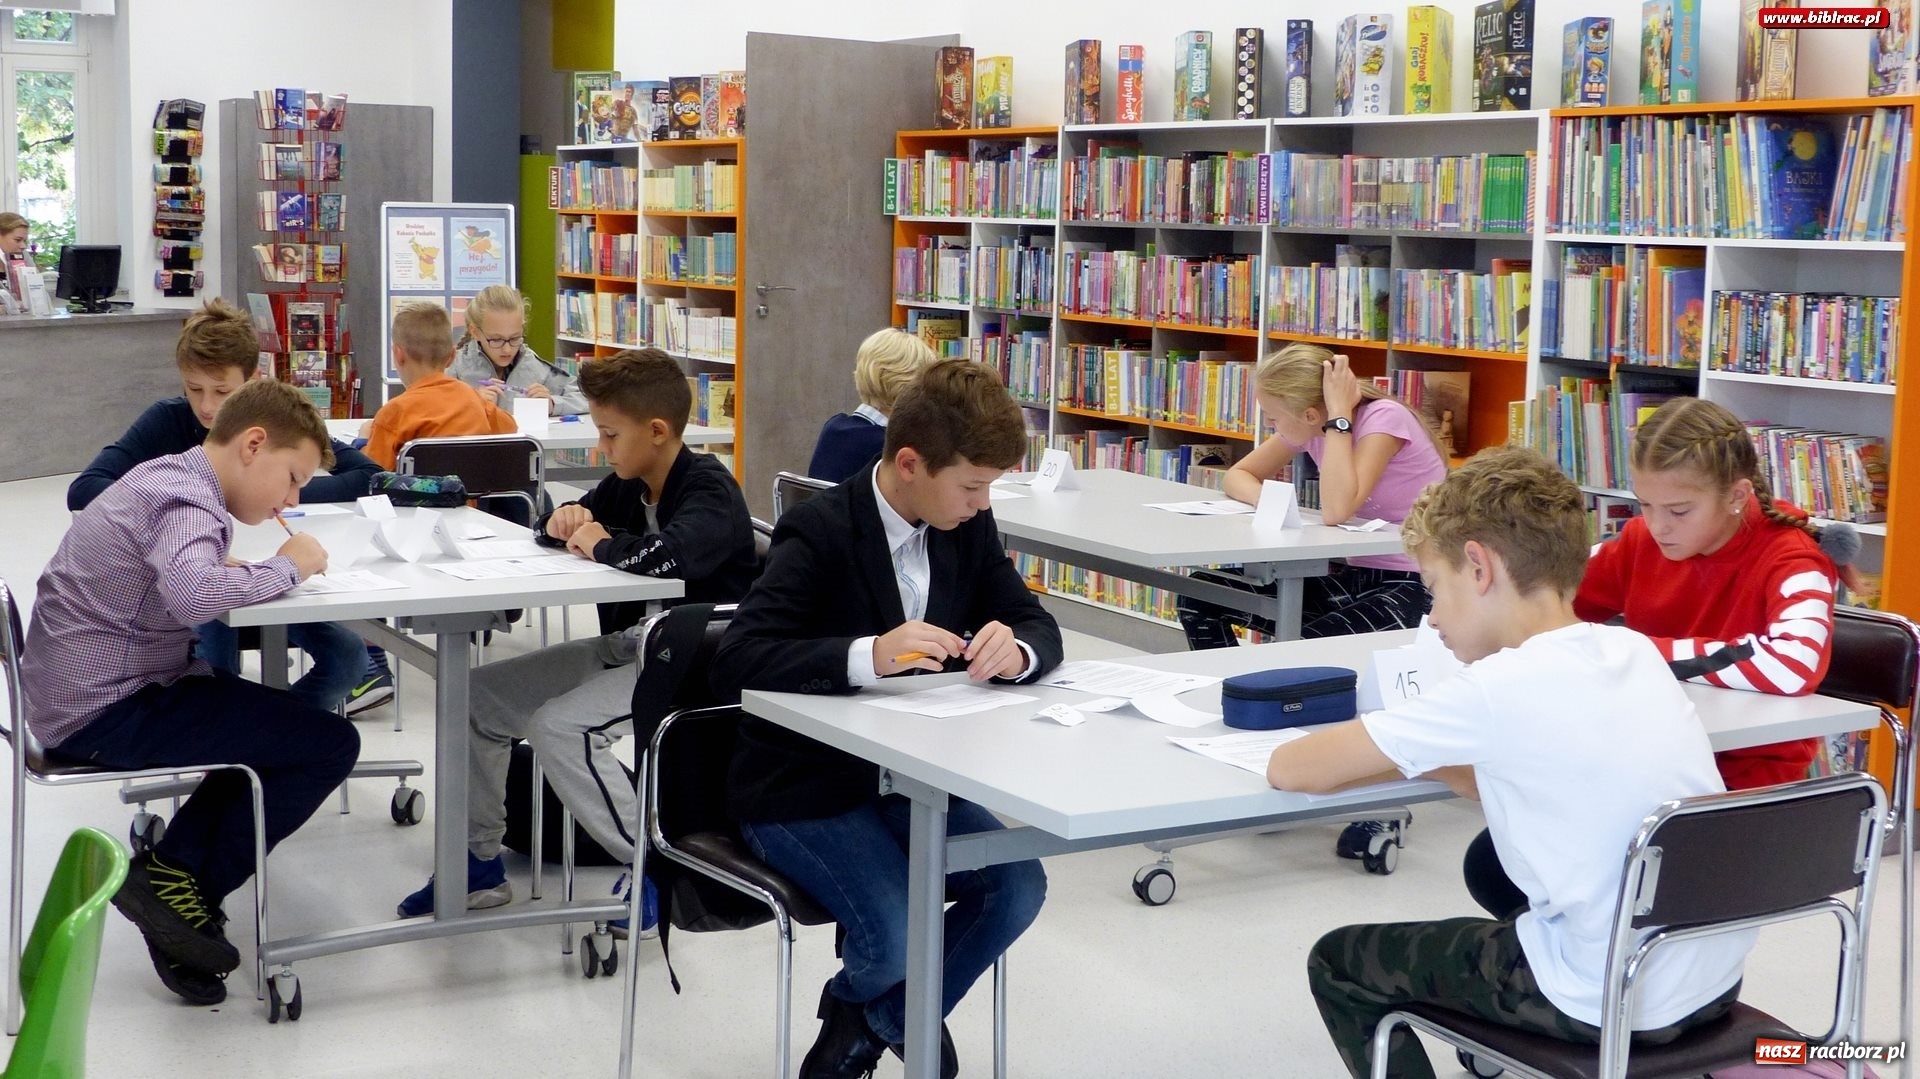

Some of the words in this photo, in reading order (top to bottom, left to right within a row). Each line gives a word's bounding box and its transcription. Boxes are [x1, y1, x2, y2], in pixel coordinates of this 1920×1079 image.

[1475, 12, 1504, 47] RELIC
[1512, 11, 1525, 48] RELIC
[1191, 48, 1202, 93] OSADNICY
[1259, 158, 1268, 216] ZWIERZĘTA
[1785, 171, 1823, 185] BAJKI
[887, 188, 895, 210] 8-11
[1107, 356, 1117, 381] LAT
[1108, 385, 1118, 410] 8-11
[1043, 461, 1058, 478] 20
[1395, 670, 1421, 699] 15
